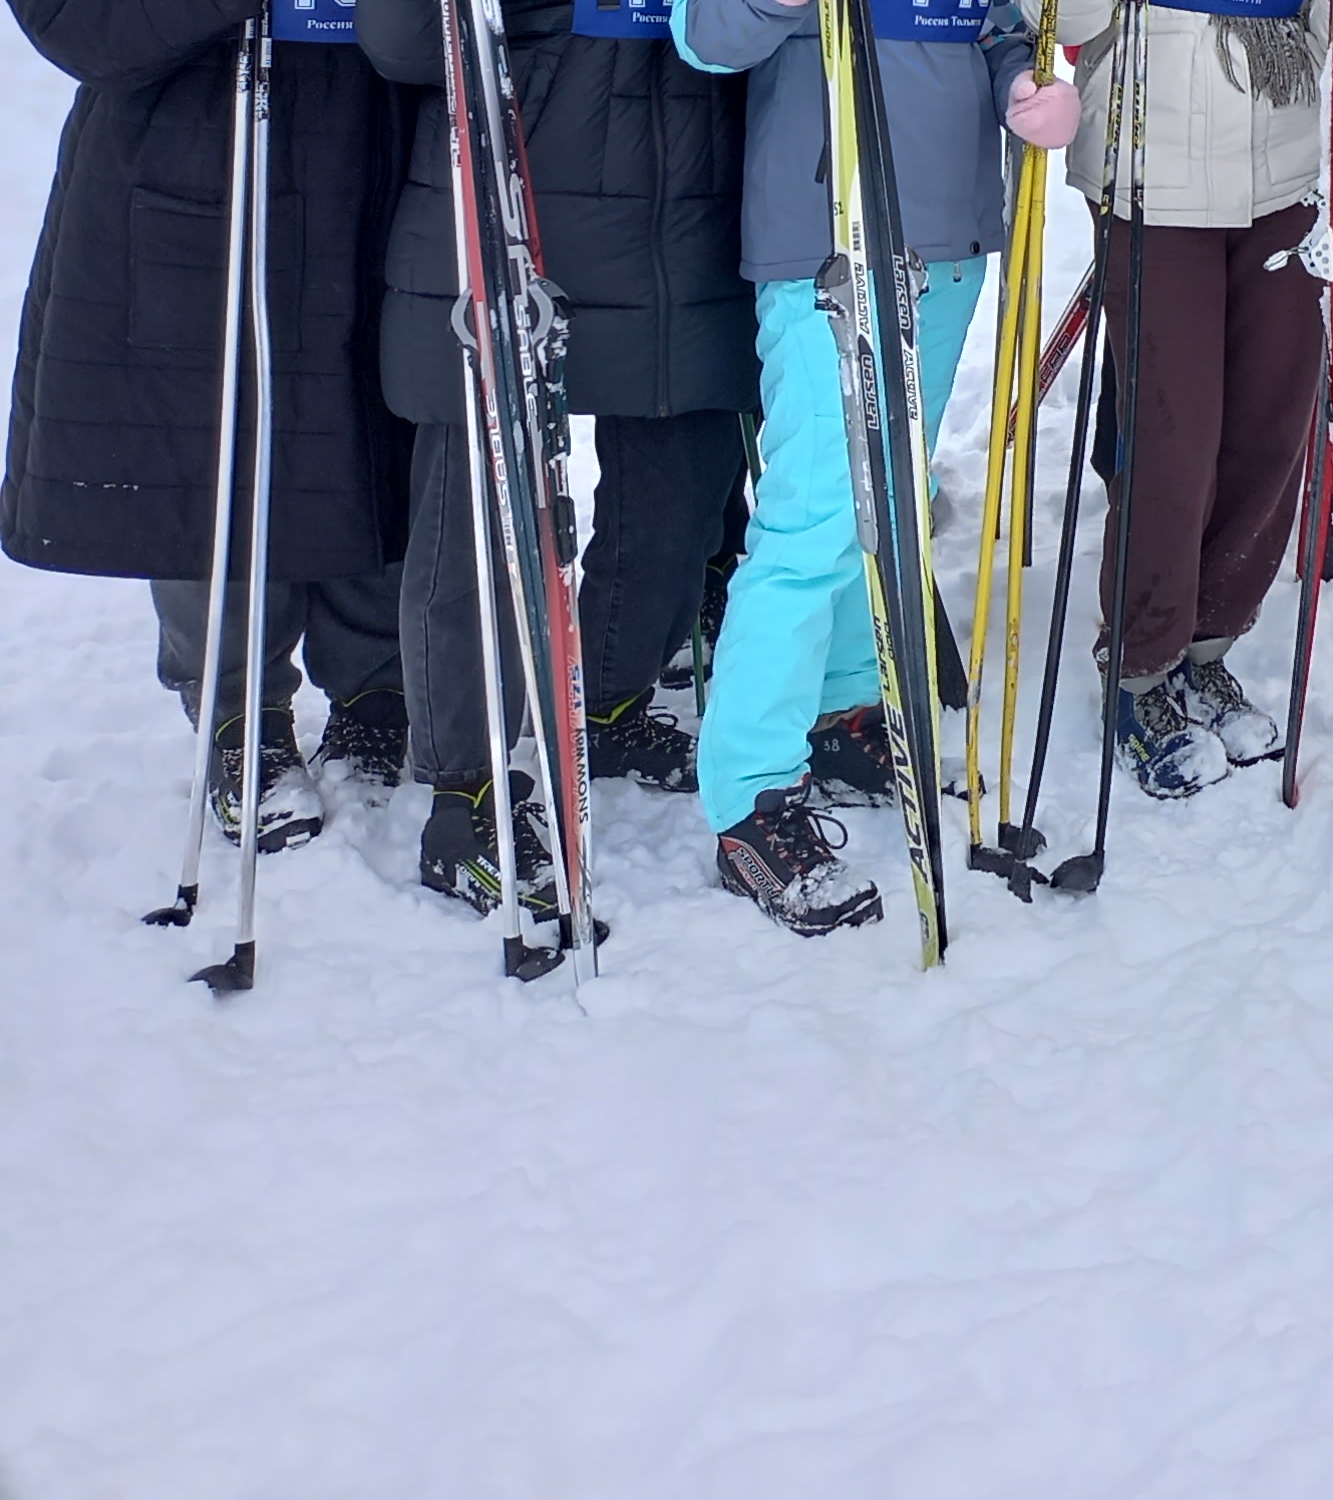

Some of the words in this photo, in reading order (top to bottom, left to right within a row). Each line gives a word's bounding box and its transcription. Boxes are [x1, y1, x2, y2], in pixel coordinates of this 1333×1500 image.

[307, 19, 353, 30] Россия
[915, 14, 949, 26] Россия
[892, 253, 911, 331] Larsen
[513, 302, 538, 417] SABLE
[862, 354, 880, 430] Larsen
[882, 701, 930, 885] ACTIVE
